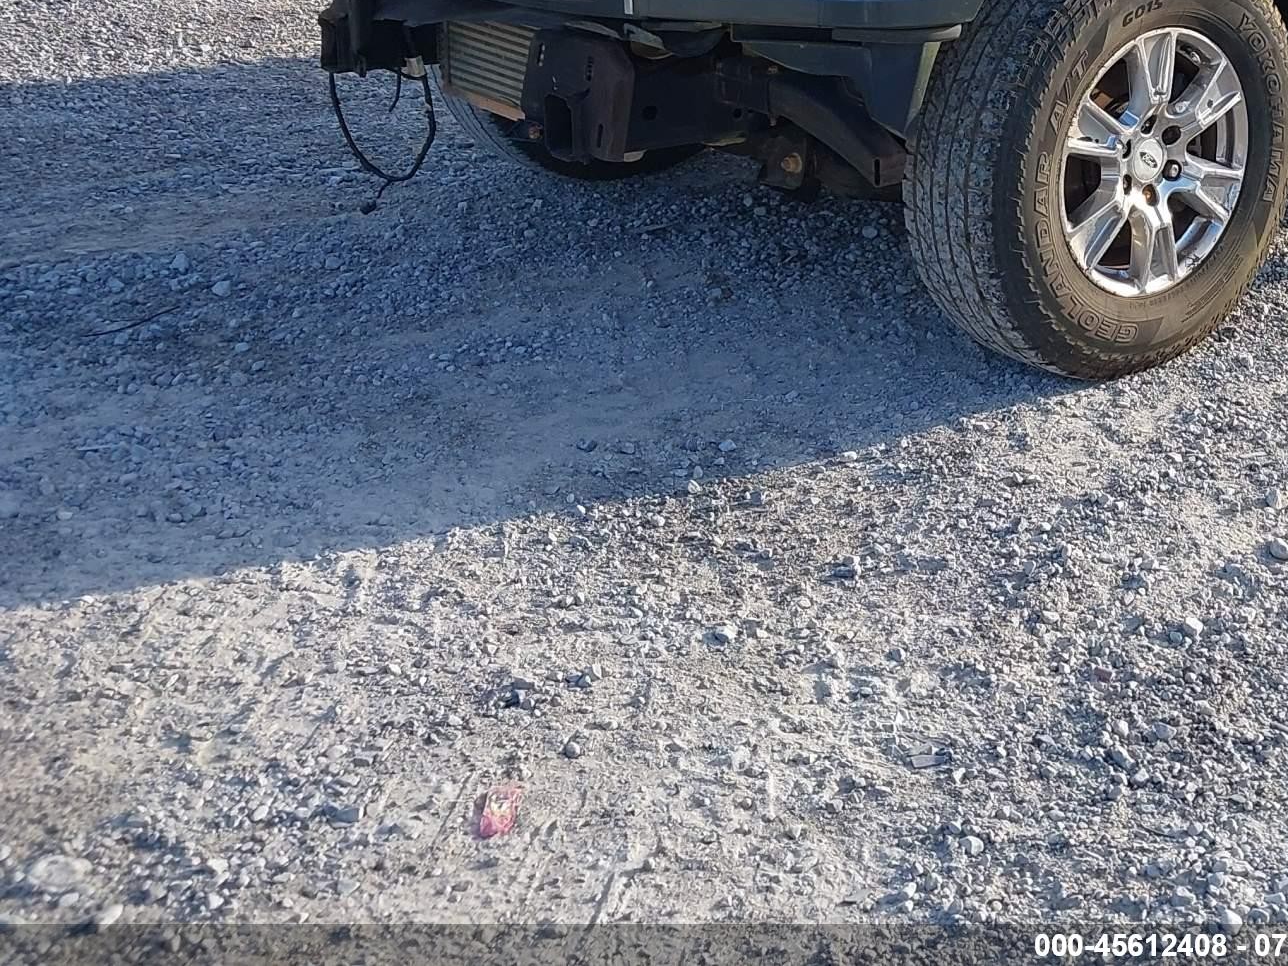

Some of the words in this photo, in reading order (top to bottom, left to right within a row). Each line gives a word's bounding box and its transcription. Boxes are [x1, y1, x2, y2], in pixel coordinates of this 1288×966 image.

[1049, 49, 1089, 135] A/T
[1238, 14, 1286, 203] YOKOHAMA
[1033, 151, 1139, 345] GEOLANDAR
